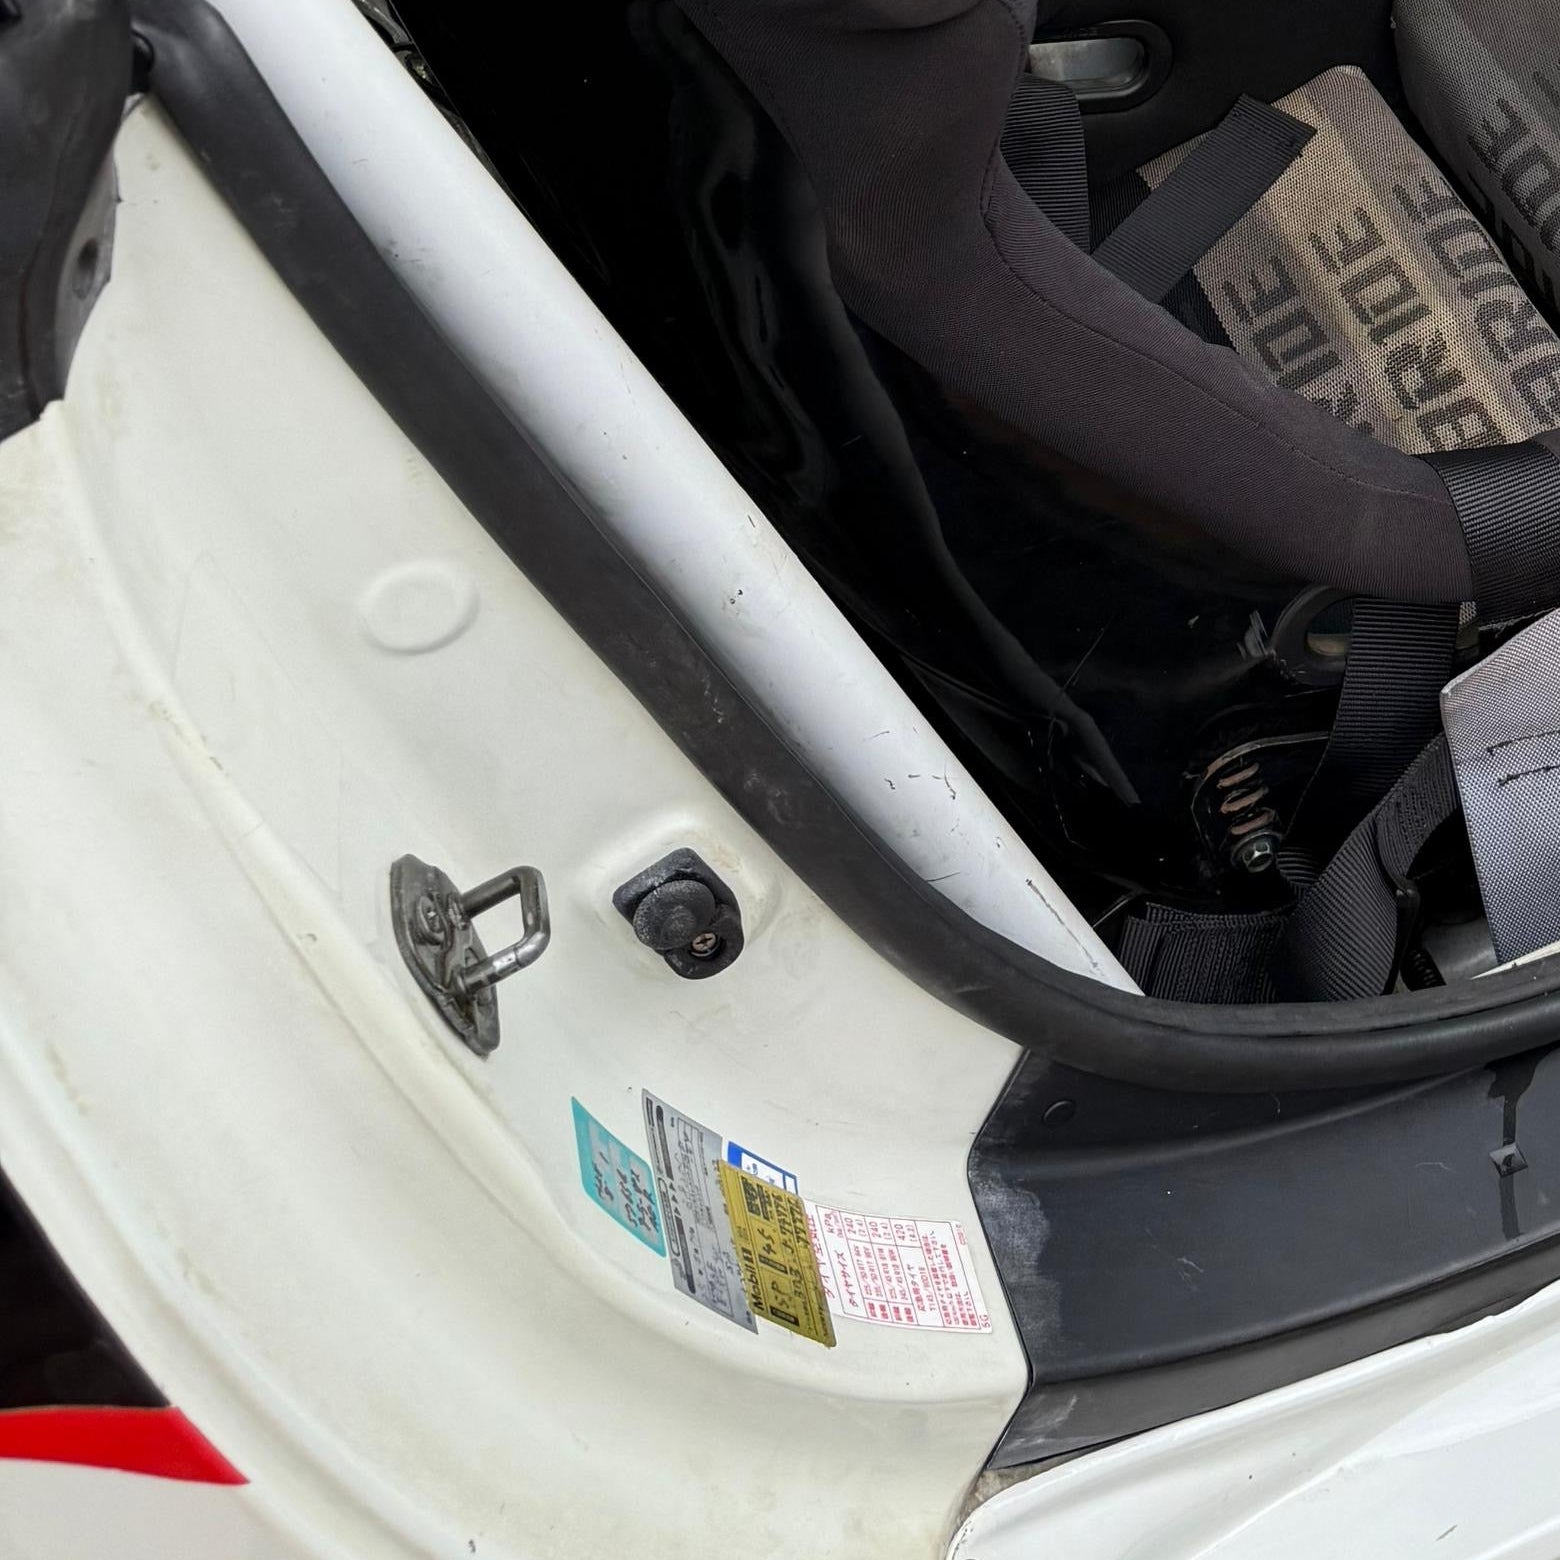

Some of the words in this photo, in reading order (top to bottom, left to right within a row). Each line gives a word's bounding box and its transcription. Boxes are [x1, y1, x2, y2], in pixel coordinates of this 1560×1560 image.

[822, 1212, 834, 1233] kPa
[845, 1217, 855, 1234] 240
[869, 1220, 880, 1238] 240
[894, 1223, 906, 1240] 420
[743, 1262, 765, 1312] Mobil
